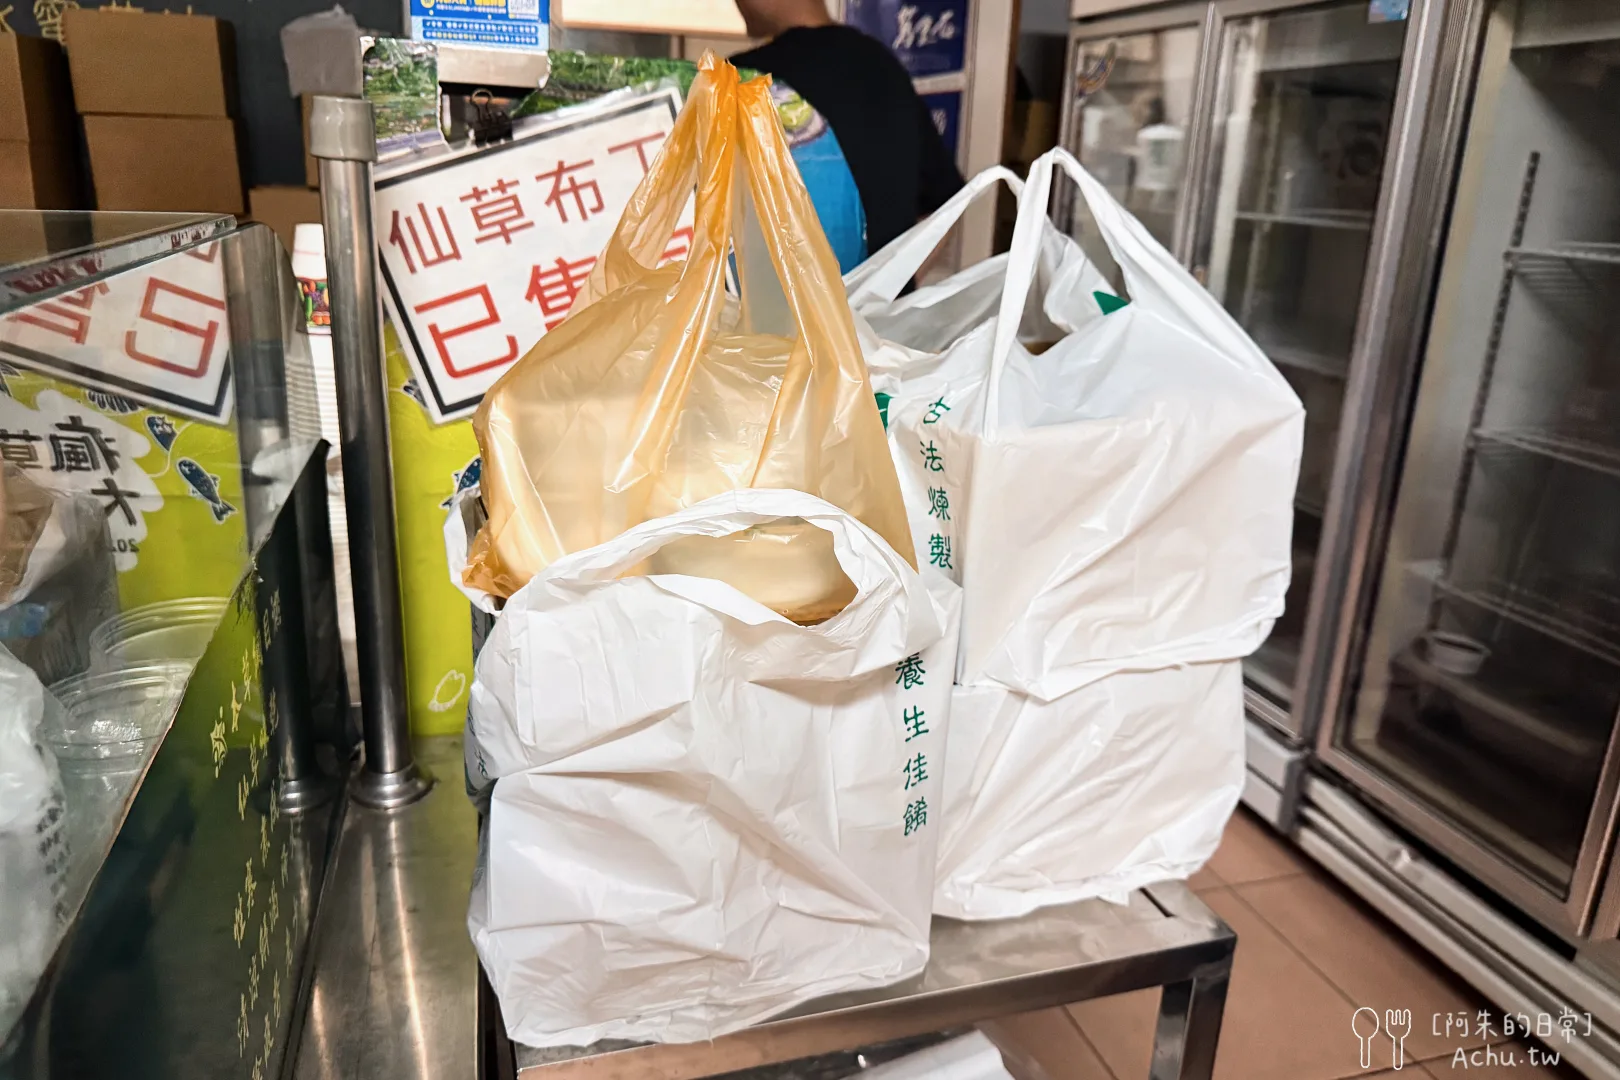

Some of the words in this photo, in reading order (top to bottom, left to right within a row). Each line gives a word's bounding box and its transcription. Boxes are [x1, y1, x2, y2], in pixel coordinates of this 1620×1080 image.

[919, 395, 953, 570] 古法煉製
[895, 652, 930, 836] 養生佳餚
